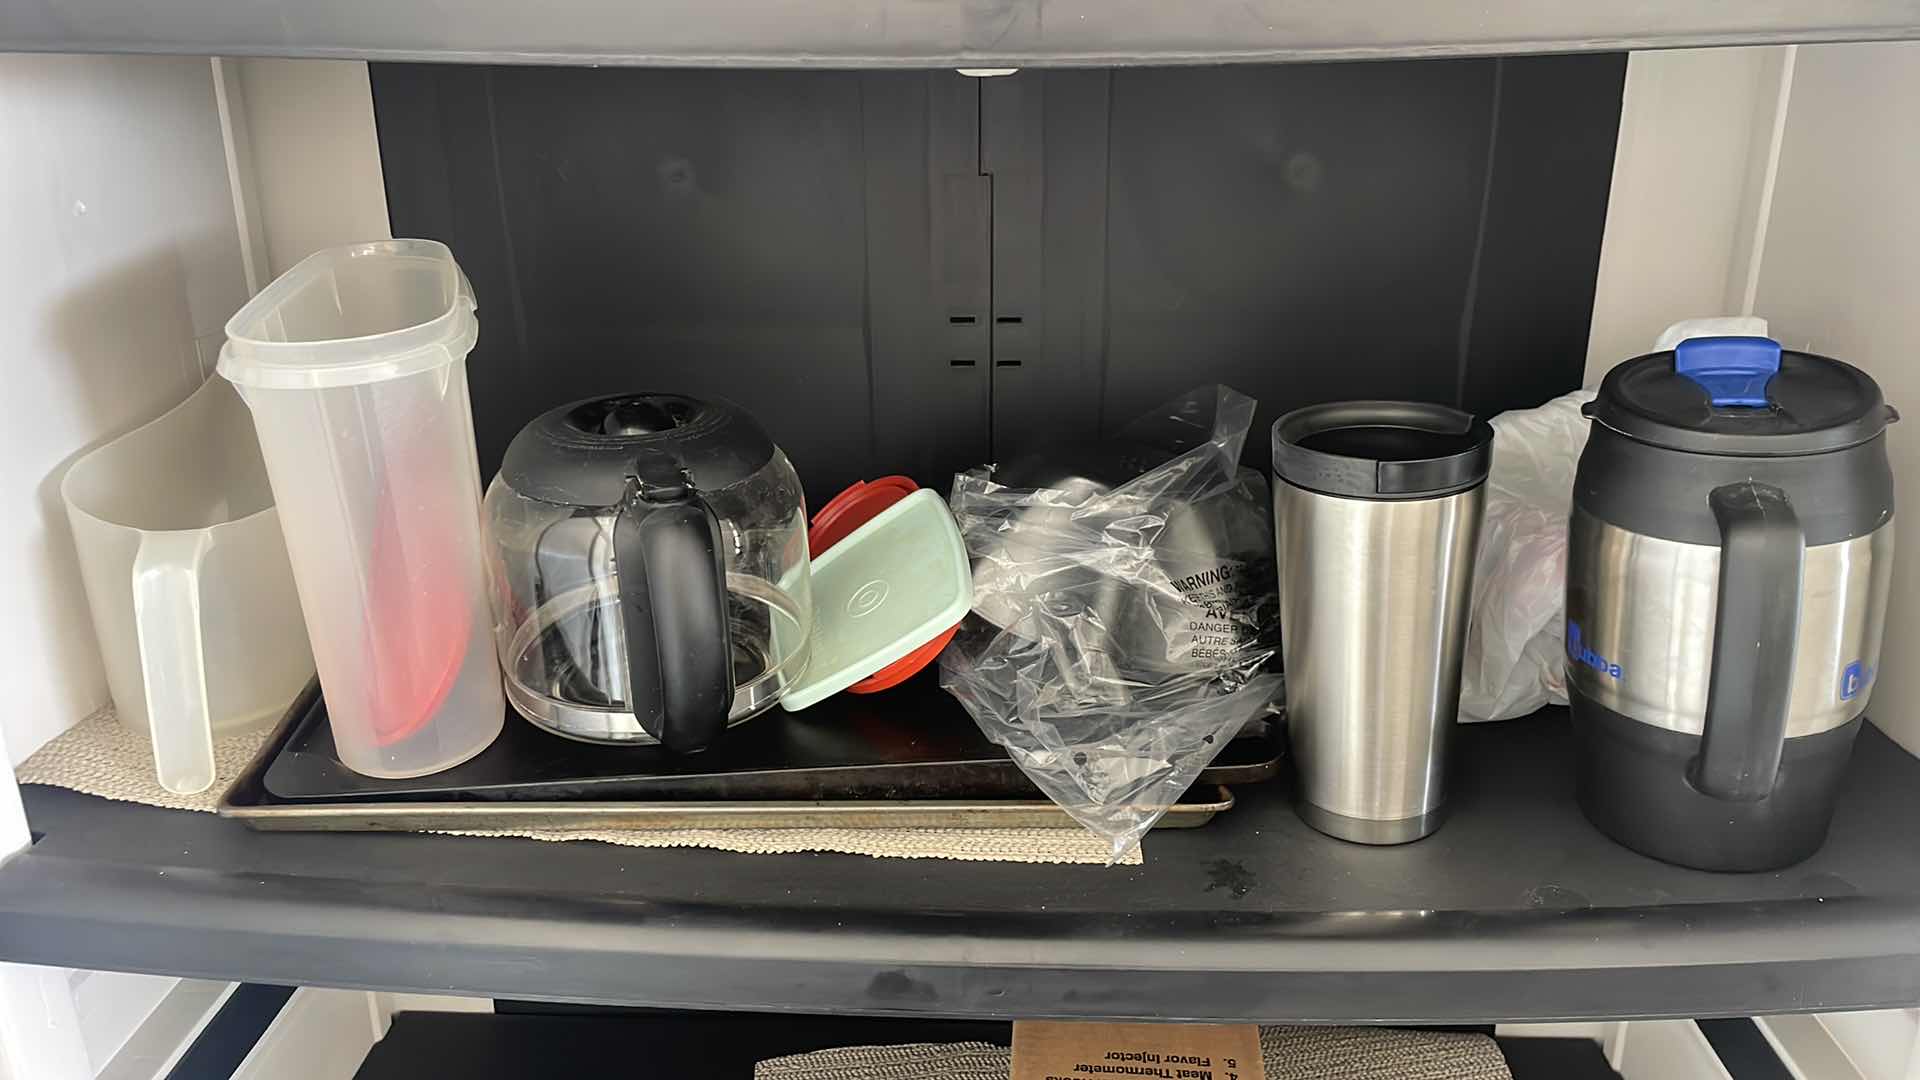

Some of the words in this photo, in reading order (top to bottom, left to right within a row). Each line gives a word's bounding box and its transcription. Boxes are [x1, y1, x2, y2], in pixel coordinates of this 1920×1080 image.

[1189, 620, 1239, 633] DANGER
[1191, 635, 1228, 646] AUTRE
[1104, 1051, 1160, 1064] Injector
[1164, 1055, 1212, 1067] Flavor
[1223, 1058, 1237, 1068] 5.
[1073, 1063, 1174, 1079] Thermometer
[1175, 1069, 1213, 1080] Meat
